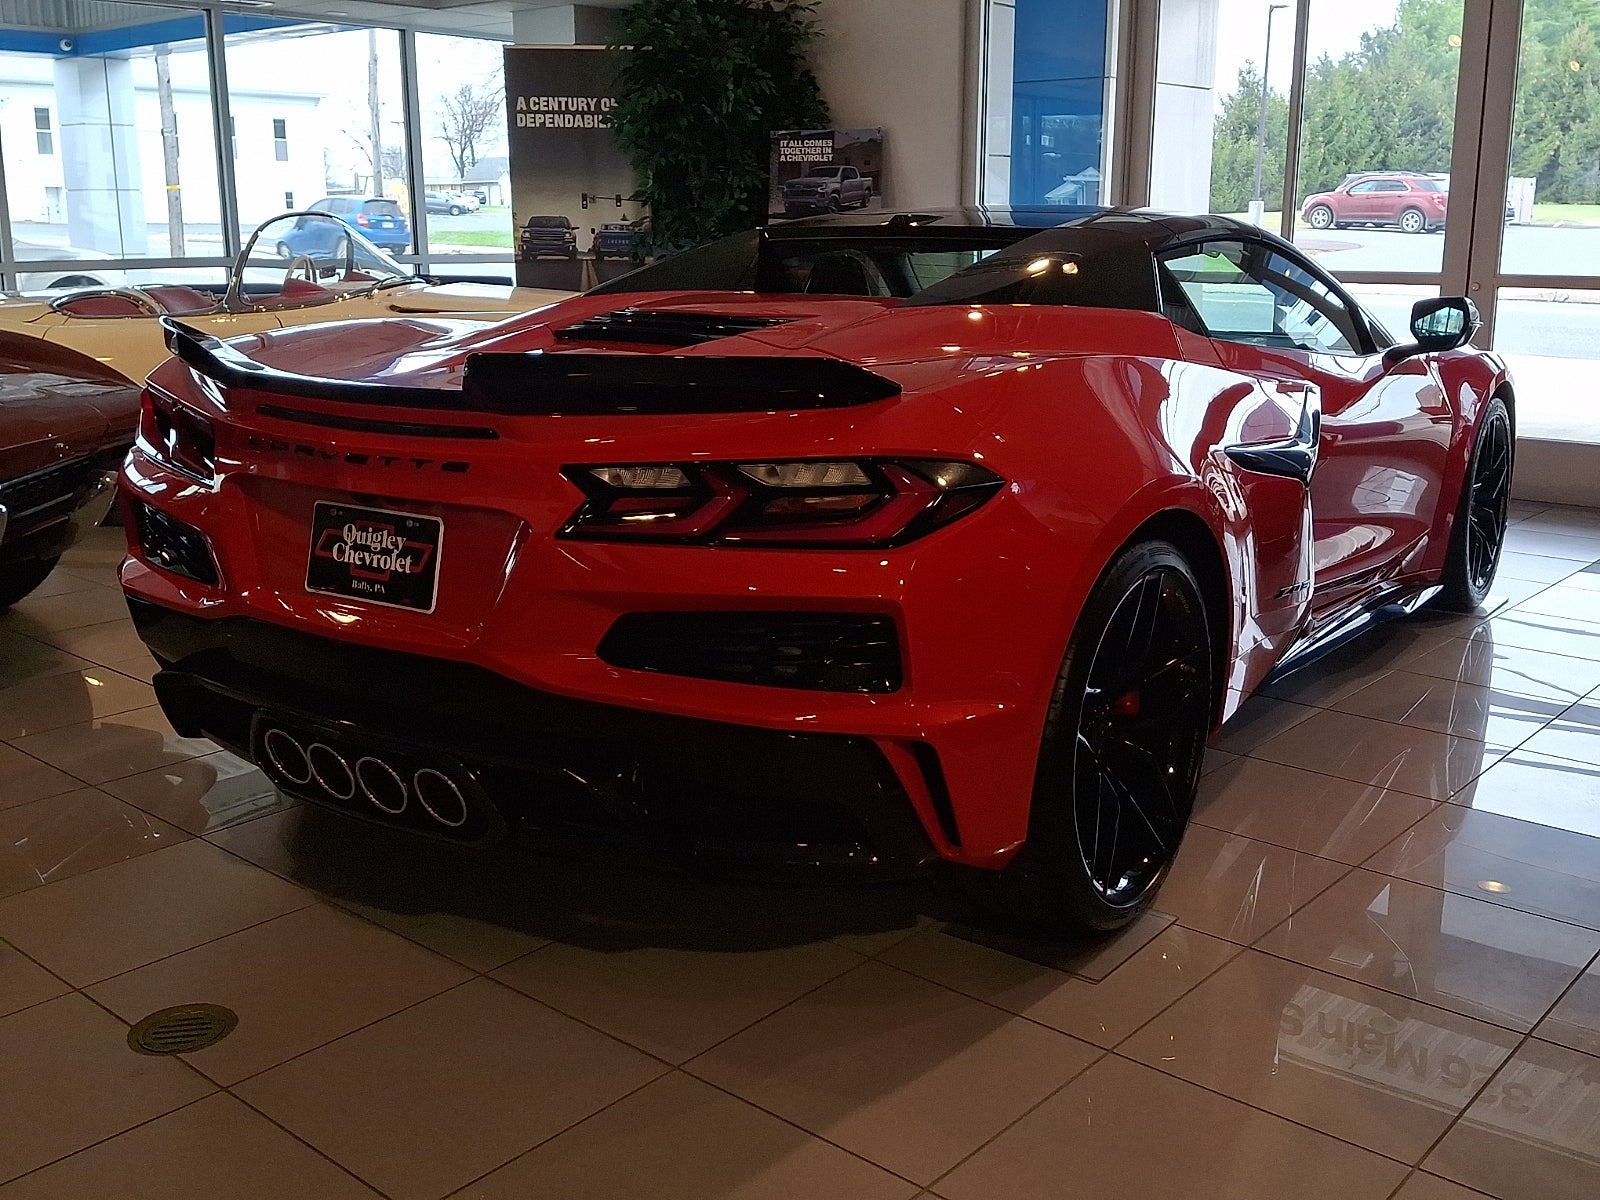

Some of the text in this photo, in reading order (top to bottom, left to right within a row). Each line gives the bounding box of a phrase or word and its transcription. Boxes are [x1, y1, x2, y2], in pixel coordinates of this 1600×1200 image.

[516, 96, 527, 111] A
[529, 96, 598, 111] CENTURY
[788, 139, 803, 147] ALL
[803, 139, 833, 147] COMES
[780, 147, 822, 155] TOGETHER
[787, 154, 833, 162] CHEVROLET
[342, 523, 407, 553] Quigley
[332, 542, 413, 573] Chevrolet
[374, 583, 386, 594] PA
